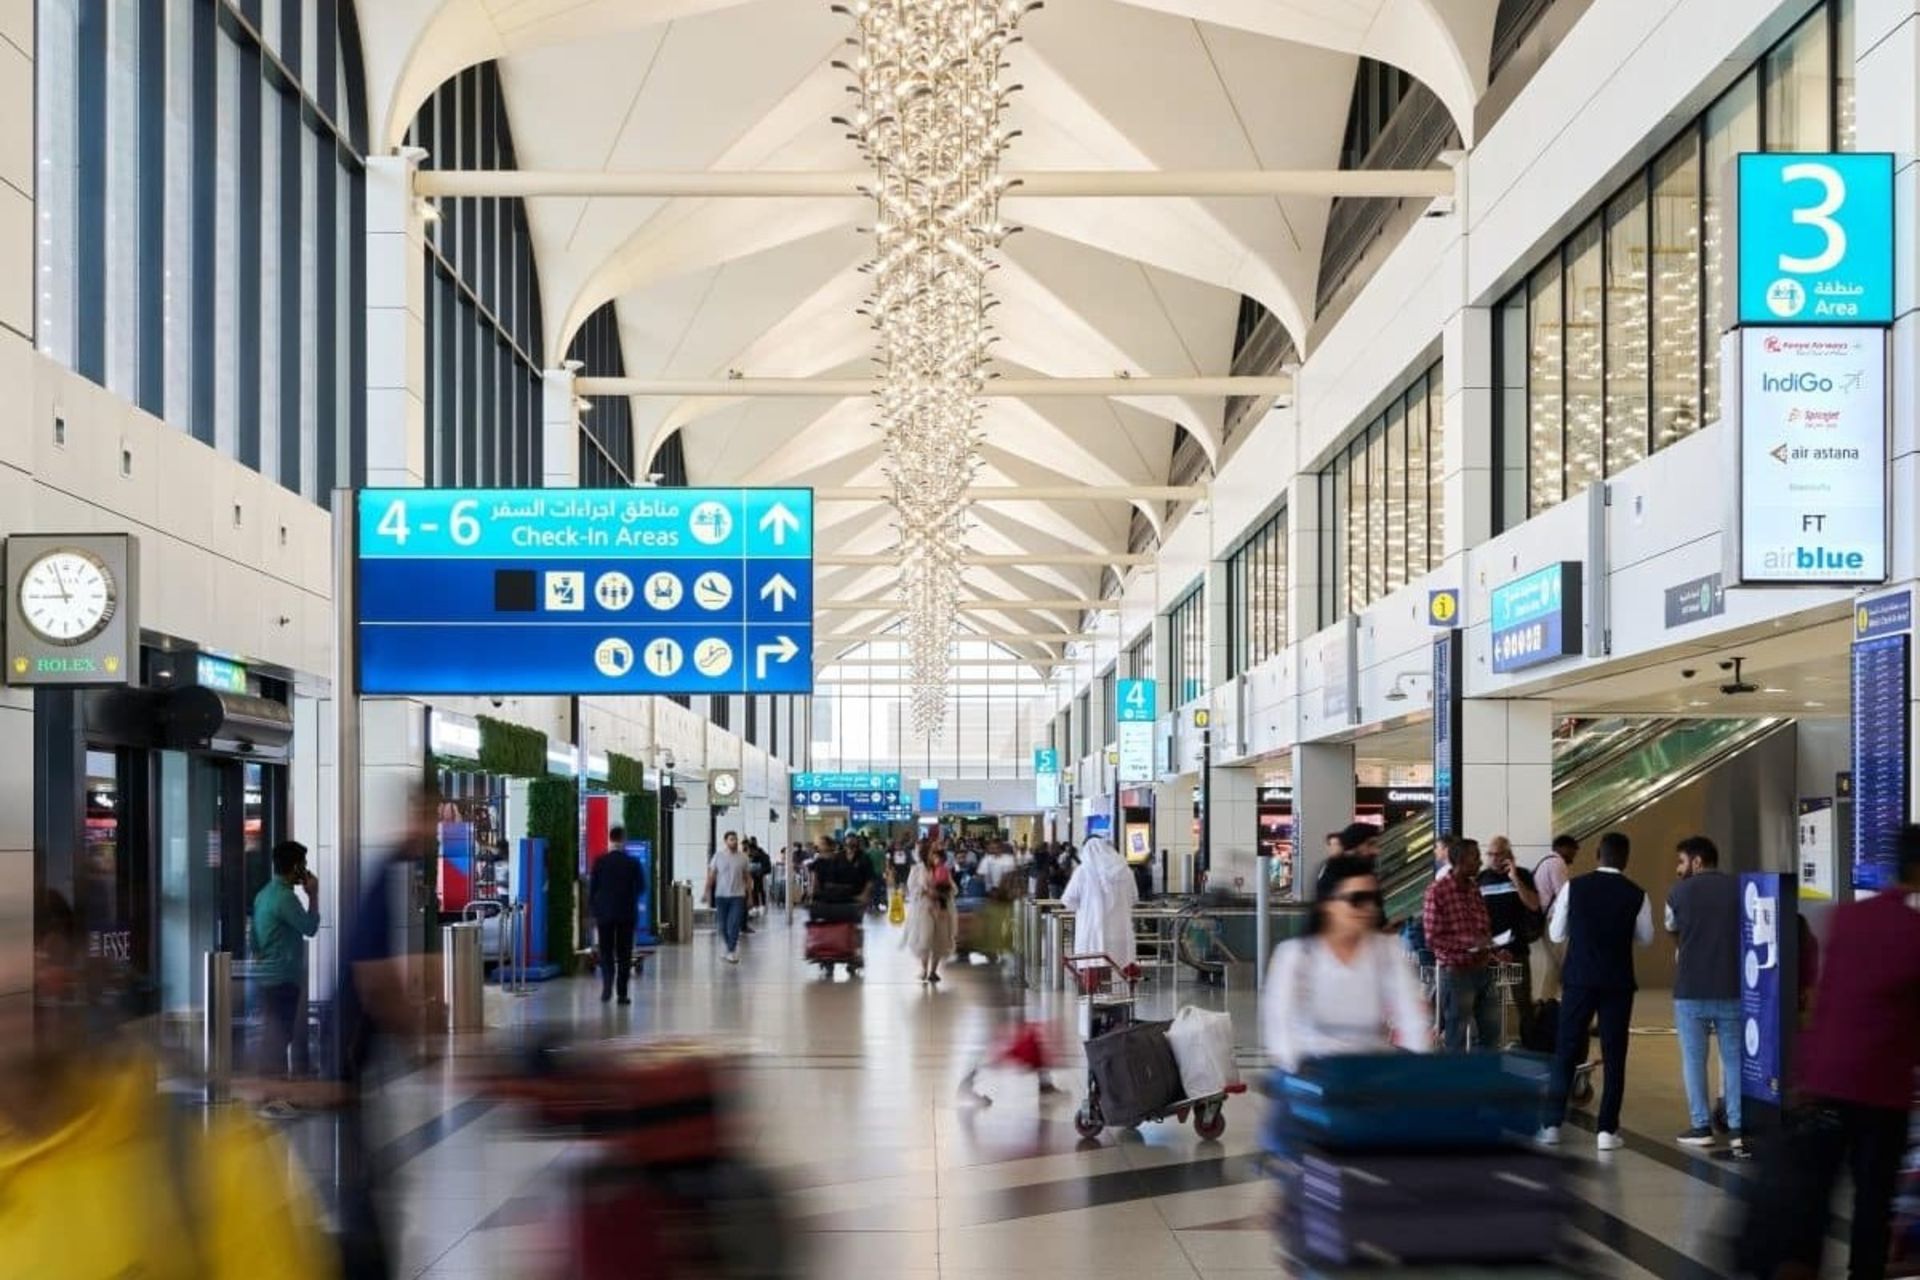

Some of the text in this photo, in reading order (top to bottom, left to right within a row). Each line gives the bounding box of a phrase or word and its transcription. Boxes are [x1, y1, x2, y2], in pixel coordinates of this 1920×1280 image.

[1778, 163, 1847, 274] 3
[1815, 299, 1858, 316] Area
[1763, 372, 1833, 392] IndiGo
[1791, 446, 1860, 460] air astana
[490, 499, 544, 520] السفر
[620, 502, 680, 523] مناطق
[376, 499, 410, 545] 4
[449, 499, 481, 546] 6
[1802, 514, 1827, 533] FT
[512, 525, 680, 547] Check-In Areas
[37, 658, 95, 672] ROLEX
[1126, 681, 1146, 708] 4
[1041, 750, 1051, 767] 5
[796, 775, 805, 788] 5
[813, 775, 822, 787] 6
